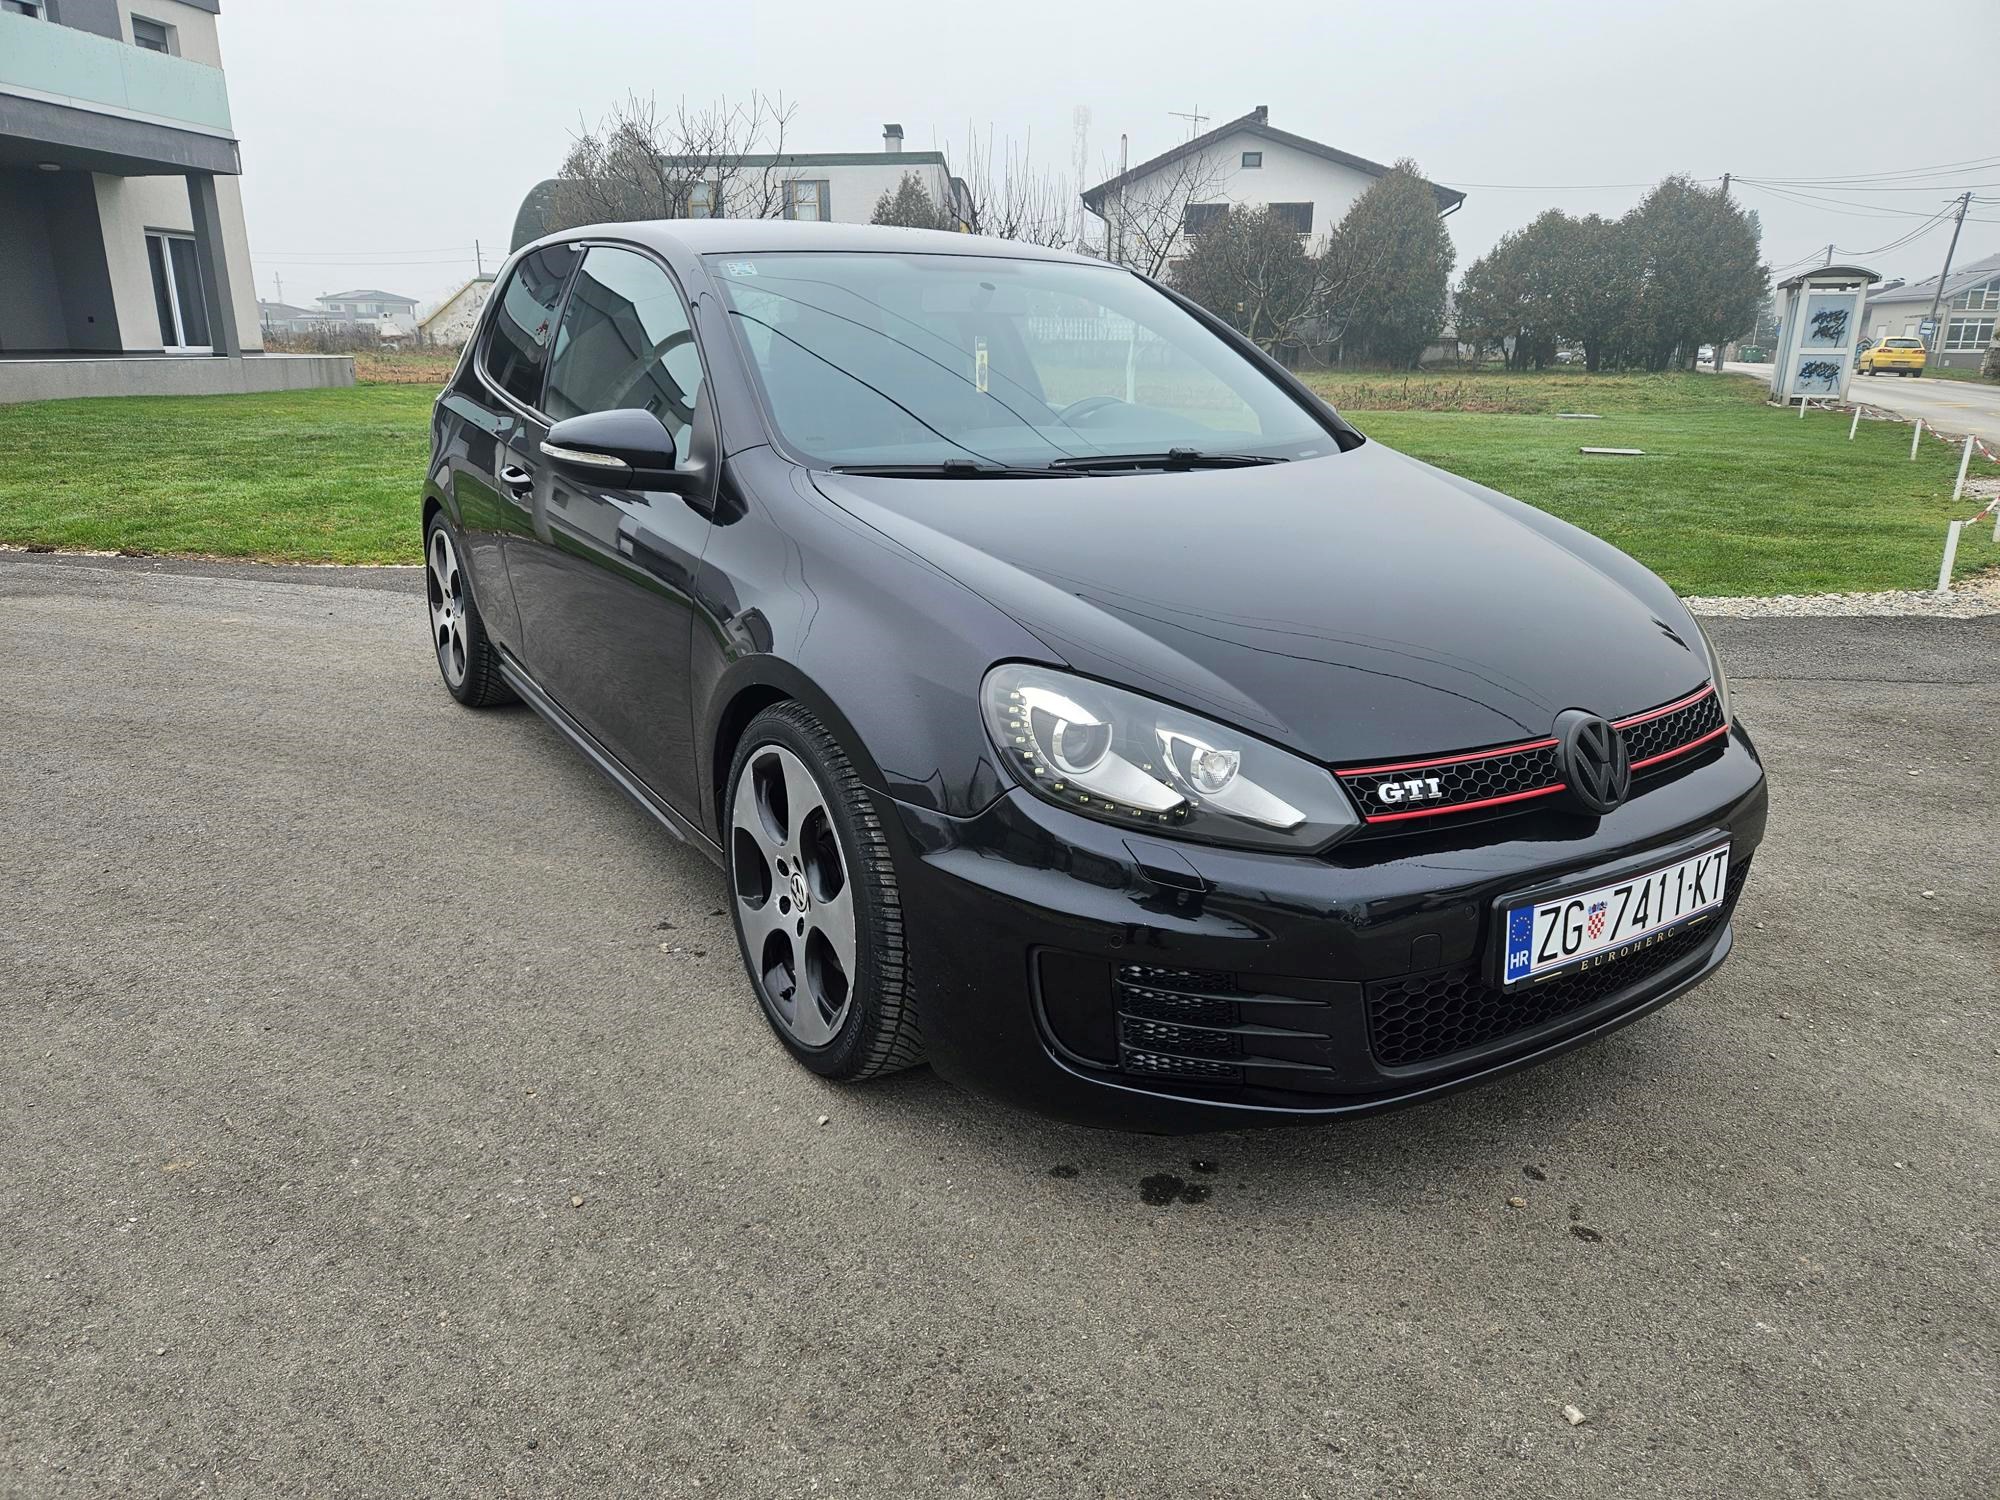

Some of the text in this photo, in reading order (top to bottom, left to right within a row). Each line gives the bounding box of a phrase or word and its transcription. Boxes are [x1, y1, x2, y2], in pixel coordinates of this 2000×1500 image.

[1378, 778, 1442, 804] GTI
[1510, 950, 1529, 969] HR
[1537, 900, 1584, 964] ZG
[1581, 927, 1675, 971] EUROHERC
